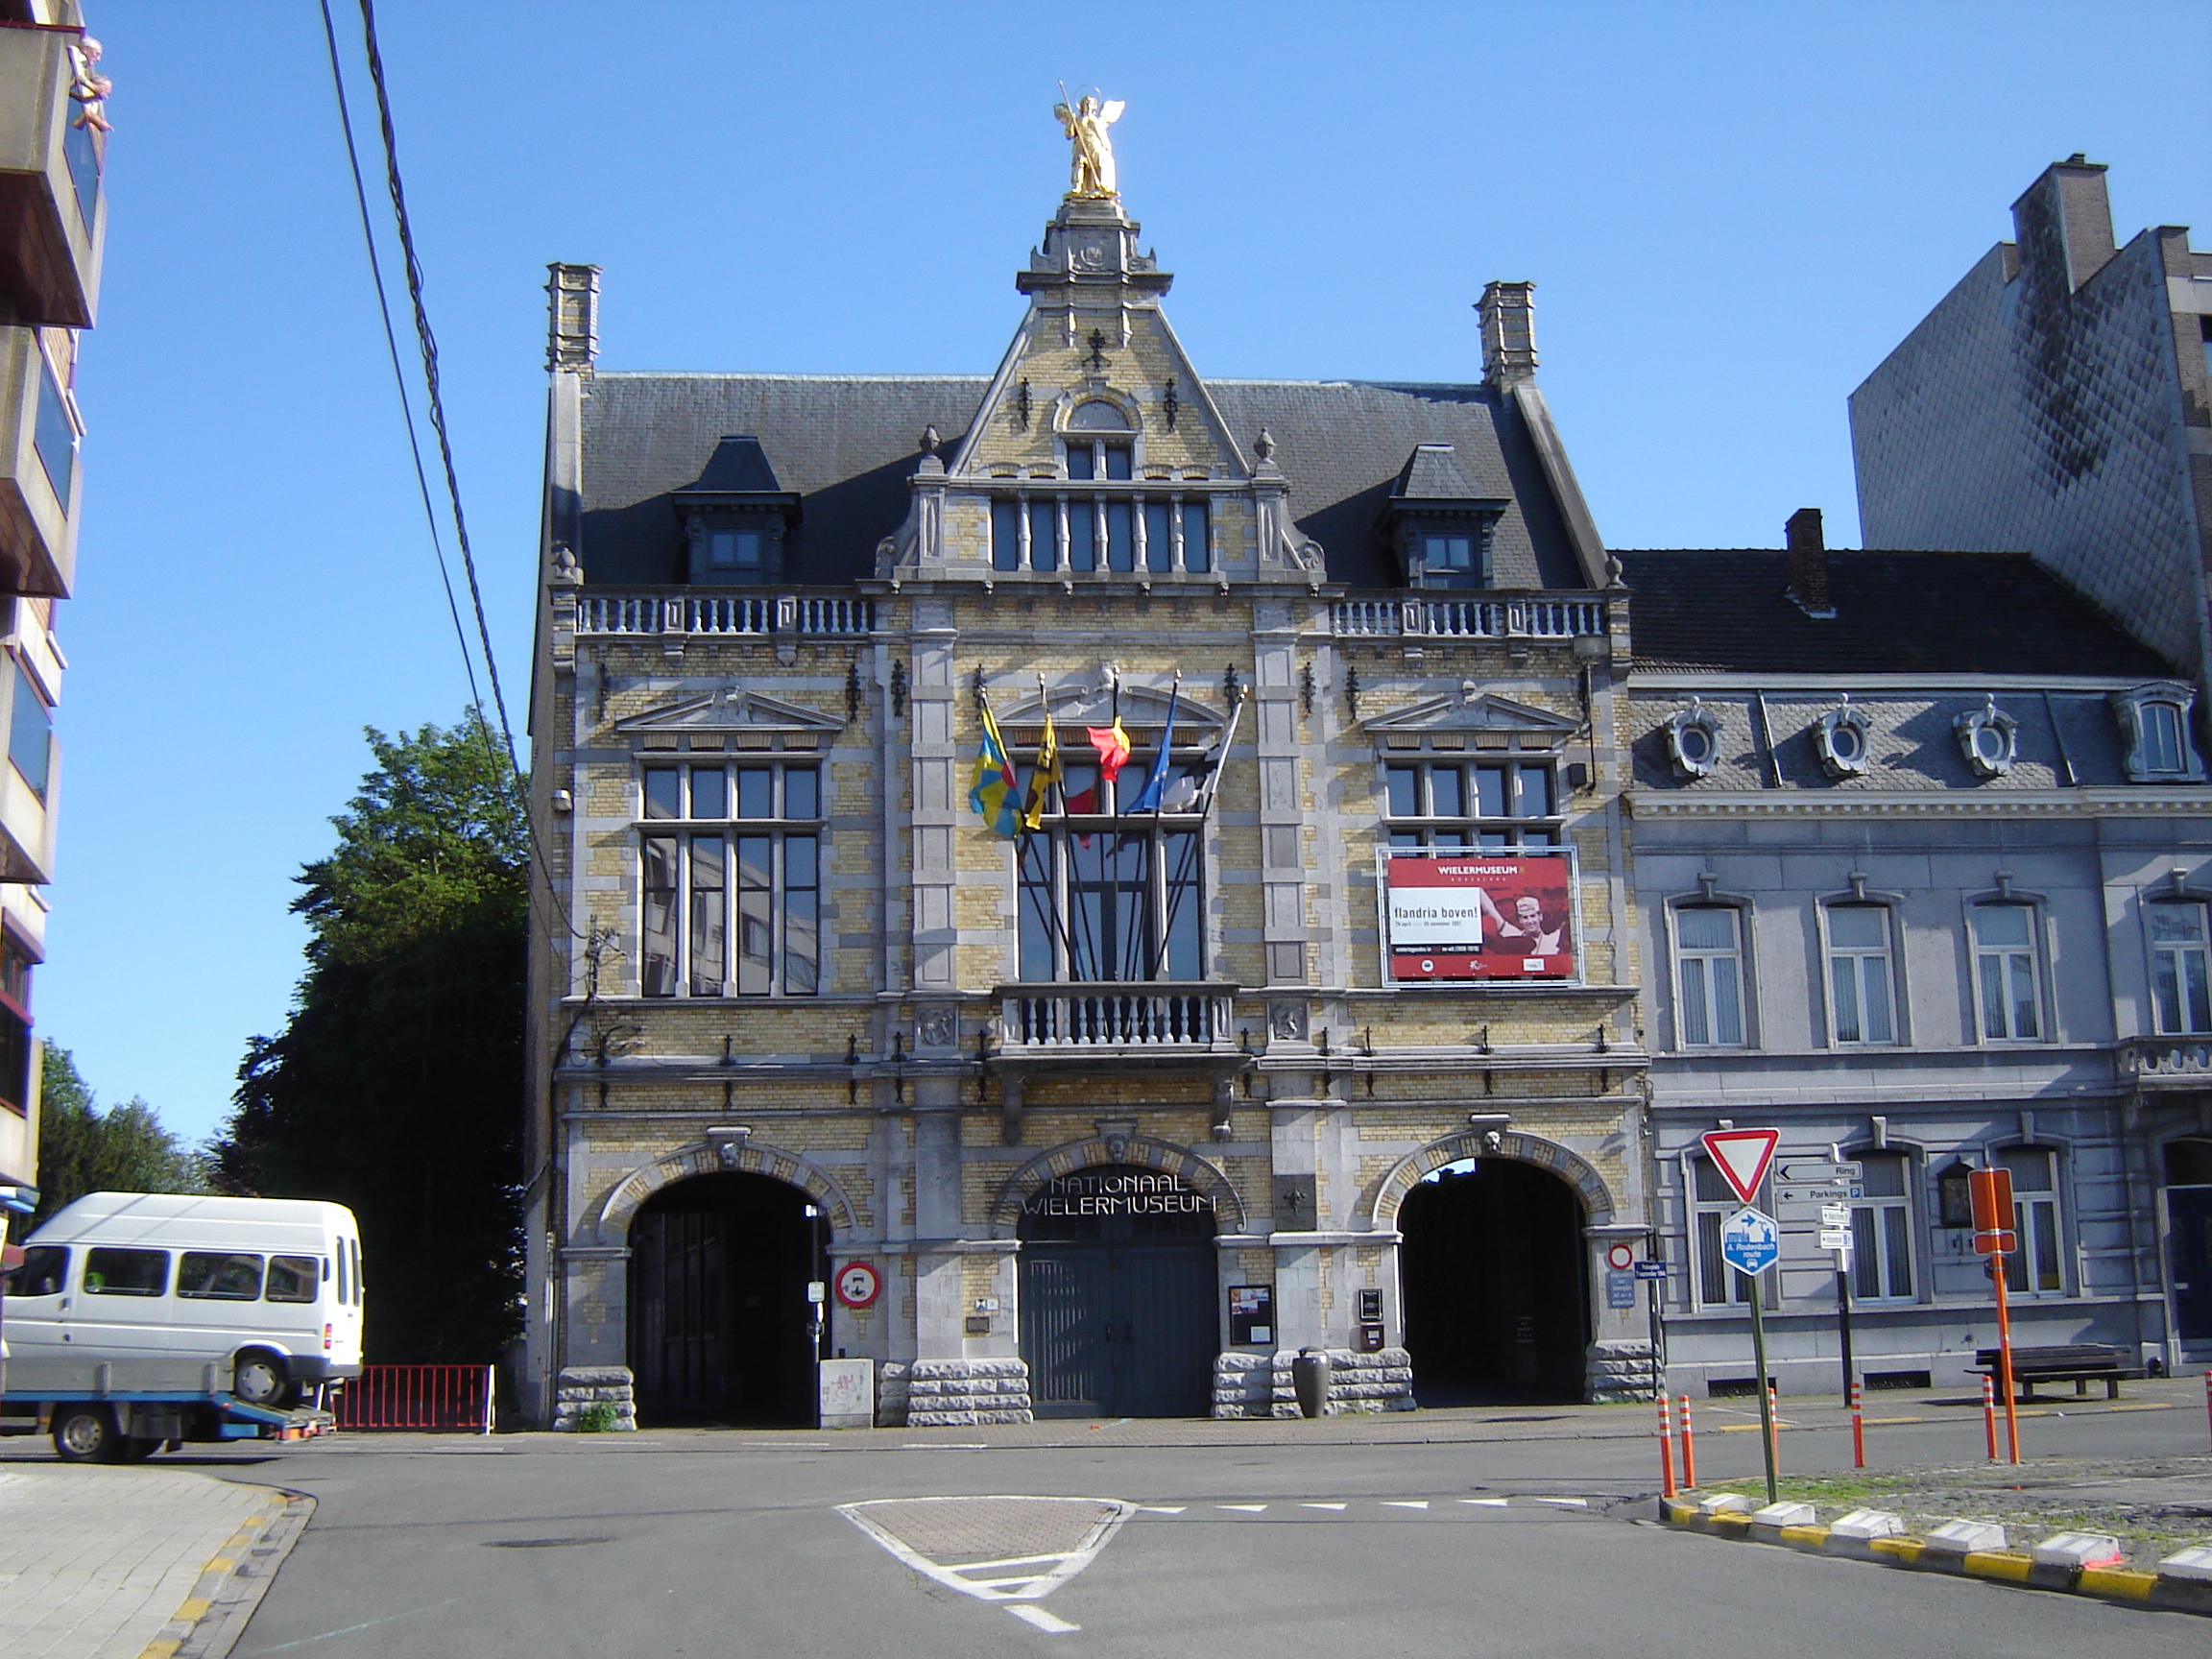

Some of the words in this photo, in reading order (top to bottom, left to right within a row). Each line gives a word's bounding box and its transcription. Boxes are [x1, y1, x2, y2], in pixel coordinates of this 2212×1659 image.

[1437, 866, 1517, 876] WIELERMUSEUM
[1395, 907, 1437, 919] flandria
[1441, 907, 1479, 919] boven!
[1836, 1166, 1856, 1176] Ring
[1051, 1174, 1189, 1194] NATIONAAL
[1810, 1190, 1848, 1199] Parkings
[1022, 1195, 1217, 1216] WIELERMUSEUM
